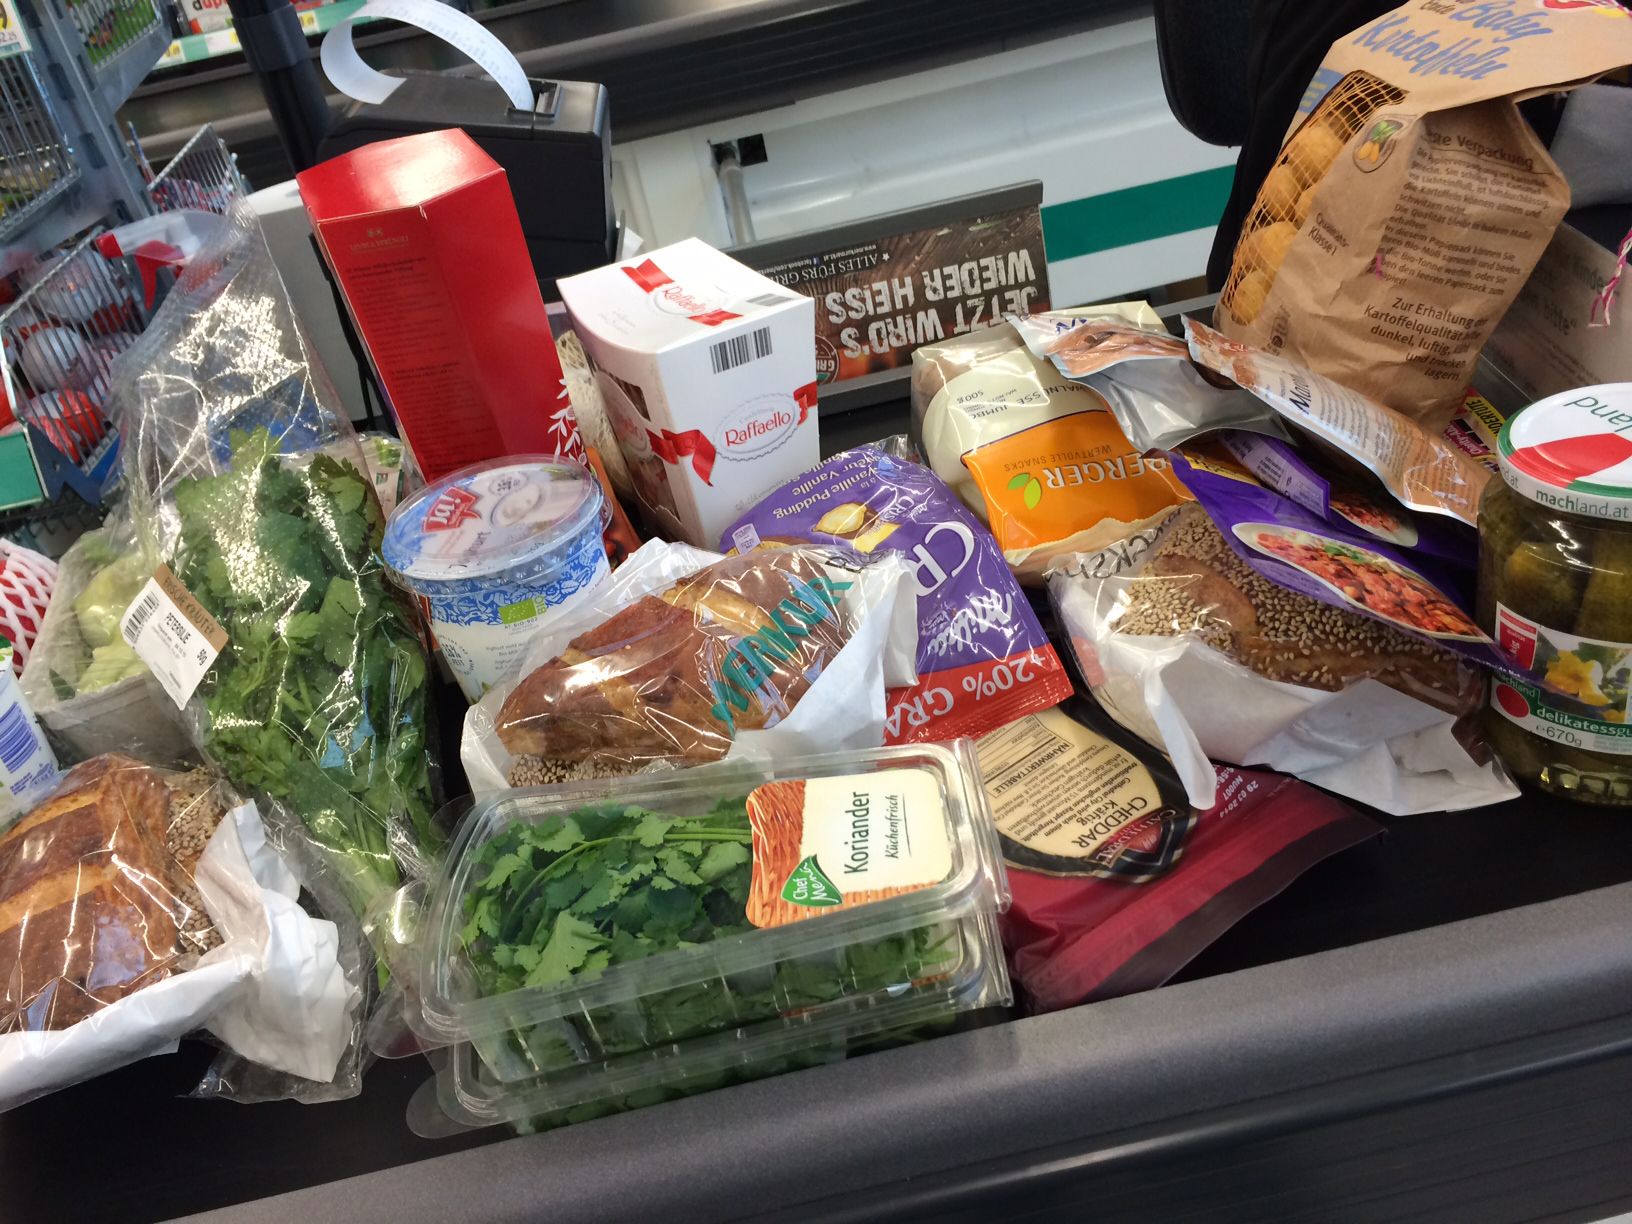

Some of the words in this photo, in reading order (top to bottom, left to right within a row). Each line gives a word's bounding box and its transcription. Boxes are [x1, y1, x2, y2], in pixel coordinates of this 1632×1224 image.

[1455, 135, 1535, 171] Verpackung
[802, 263, 836, 281] FÜRS
[838, 253, 879, 273] ALLES
[921, 249, 1033, 302] WIEDER
[770, 272, 800, 287] GRI
[824, 275, 916, 325] HEISS
[949, 286, 1037, 333] JETZT
[1391, 296, 1415, 313] Zur
[1415, 303, 1475, 330] Erhaltung
[838, 308, 944, 359] WIRD'S
[1363, 303, 1463, 343] Kartoffelqualität
[1405, 352, 1429, 365] und
[724, 408, 792, 447] Raffaello
[1003, 456, 1047, 472] SNACKS
[1049, 444, 1112, 463] WERTVOLLE
[791, 469, 839, 496] Vanille
[830, 465, 877, 493] Vanille
[772, 489, 831, 519] Pudding
[1535, 489, 1630, 520] machland.at
[534, 595, 547, 615] BIO
[925, 590, 1015, 657] Milka
[711, 576, 854, 738] MERKUR
[883, 686, 956, 743] GRA
[992, 740, 1071, 796] NÄHRWERTTABELLE
[1100, 761, 1138, 790] traditionellen
[1070, 786, 1102, 809] englischen
[1089, 793, 1104, 808] City
[1101, 776, 1132, 800] Cathedral
[1062, 812, 1078, 827] nach
[1071, 793, 1149, 852] CHEDDAR
[1075, 798, 1118, 829] Kräftig
[1078, 803, 1091, 816] wird
[844, 792, 870, 875] Koriander
[884, 794, 901, 860] Küchenfrisch
[1044, 822, 1064, 838] einem
[792, 877, 808, 900] Chef
[809, 860, 840, 905] Menü
